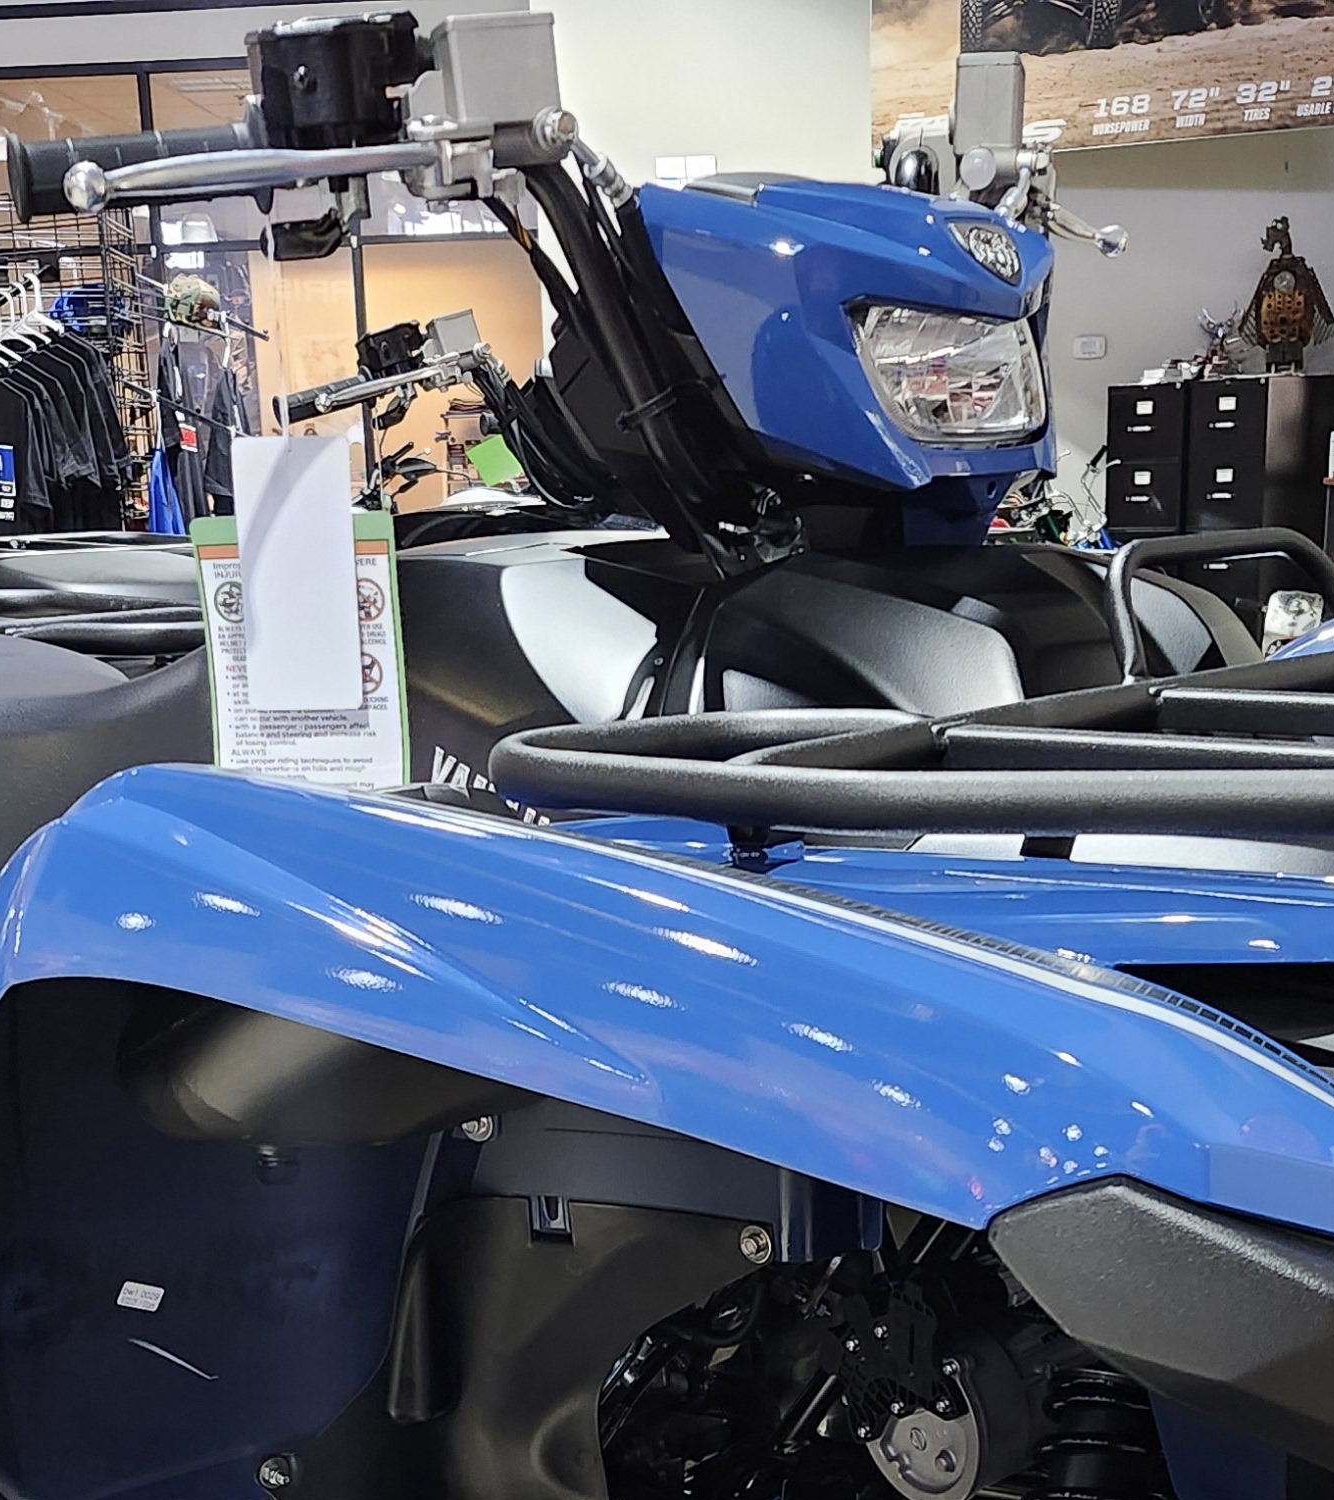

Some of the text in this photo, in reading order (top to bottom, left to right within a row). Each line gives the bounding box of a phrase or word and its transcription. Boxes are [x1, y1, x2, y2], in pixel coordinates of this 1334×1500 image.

[1171, 86, 1220, 111] 72"
[1236, 80, 1291, 104] 32"
[1094, 94, 1150, 118] 168
[1296, 102, 1332, 117] USABLE
[1176, 114, 1206, 128] WIDTH
[1244, 108, 1271, 121] TIRES
[1092, 120, 1150, 136] HORSEPOWER
[214, 571, 242, 579] INJUR
[226, 665, 247, 673] NEVE
[282, 731, 312, 739] steering
[245, 739, 267, 747] losing
[278, 757, 298, 765] riding
[300, 757, 341, 765] techniques
[344, 765, 366, 773] rough
